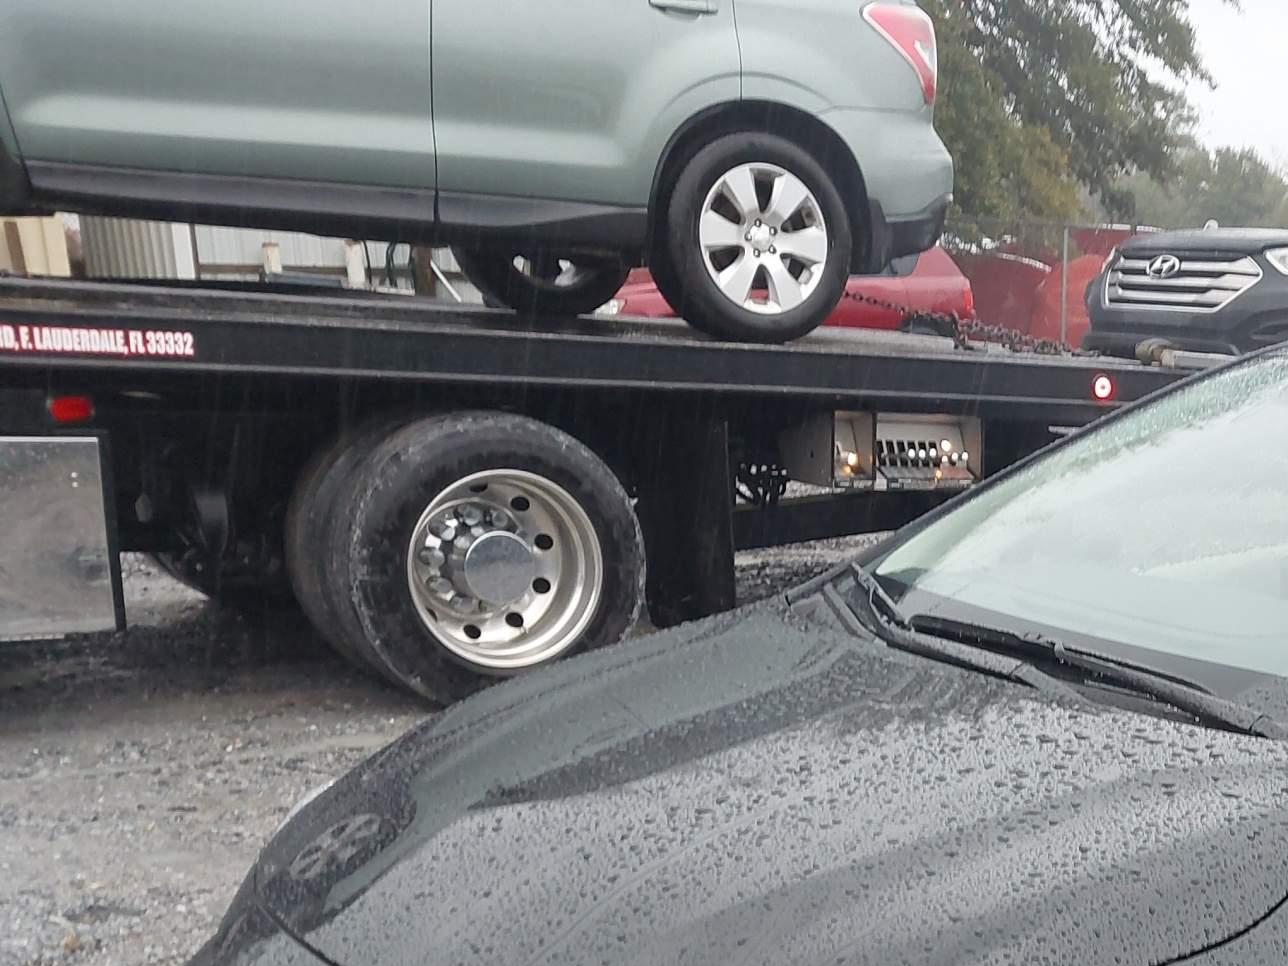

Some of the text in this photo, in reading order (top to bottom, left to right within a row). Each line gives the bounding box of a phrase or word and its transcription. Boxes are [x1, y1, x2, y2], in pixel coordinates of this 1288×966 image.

[19, 325, 33, 350] F.
[33, 327, 128, 355] LAUDERDALE,
[128, 330, 146, 354] FL
[145, 331, 194, 356] 33332
